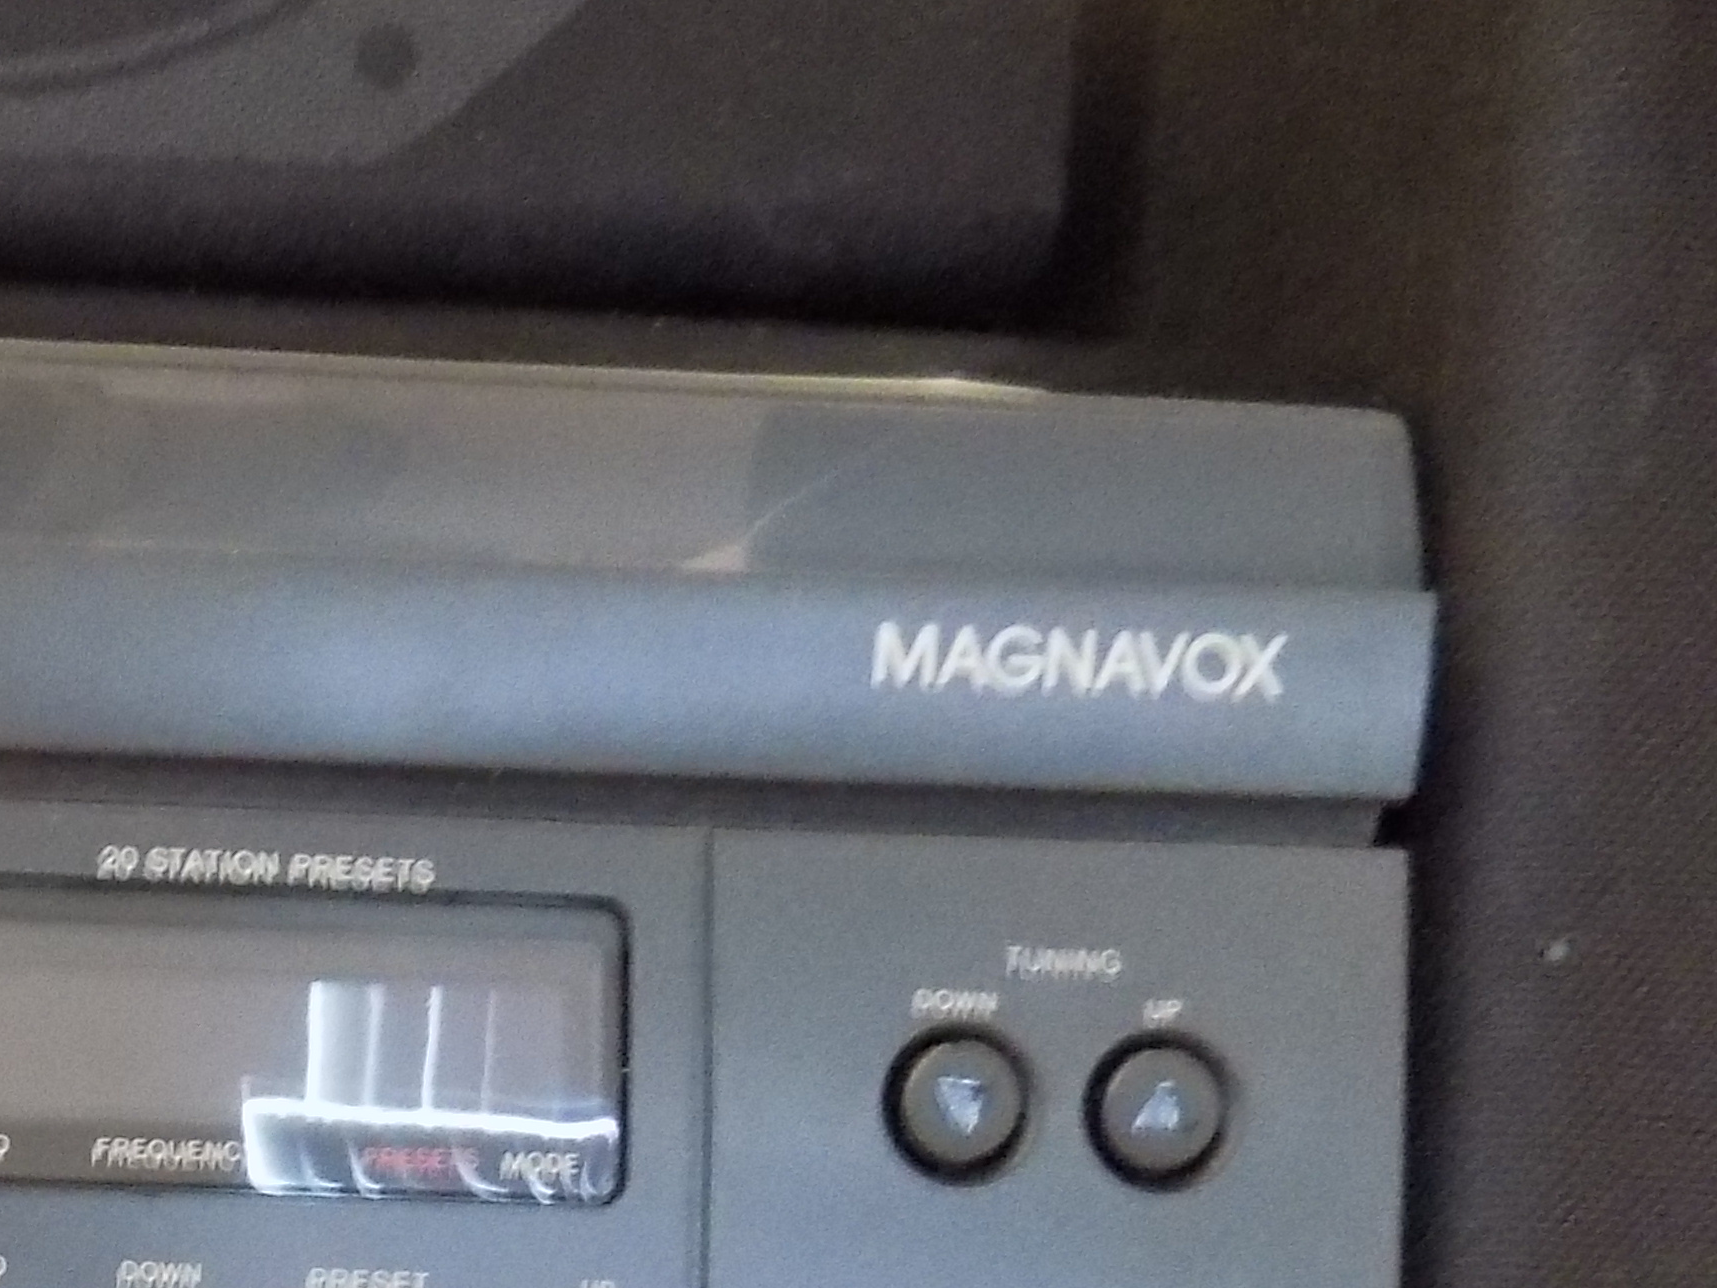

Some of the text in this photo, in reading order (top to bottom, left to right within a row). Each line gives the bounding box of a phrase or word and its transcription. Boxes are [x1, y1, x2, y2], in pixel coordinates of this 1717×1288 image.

[870, 620, 1289, 701] MAGNAVOX
[97, 845, 436, 895] 20 STATION PRESETS
[1006, 944, 1123, 983] TUNING
[91, 1137, 246, 1172] FREQUENC
[499, 1151, 581, 1181] MODE
